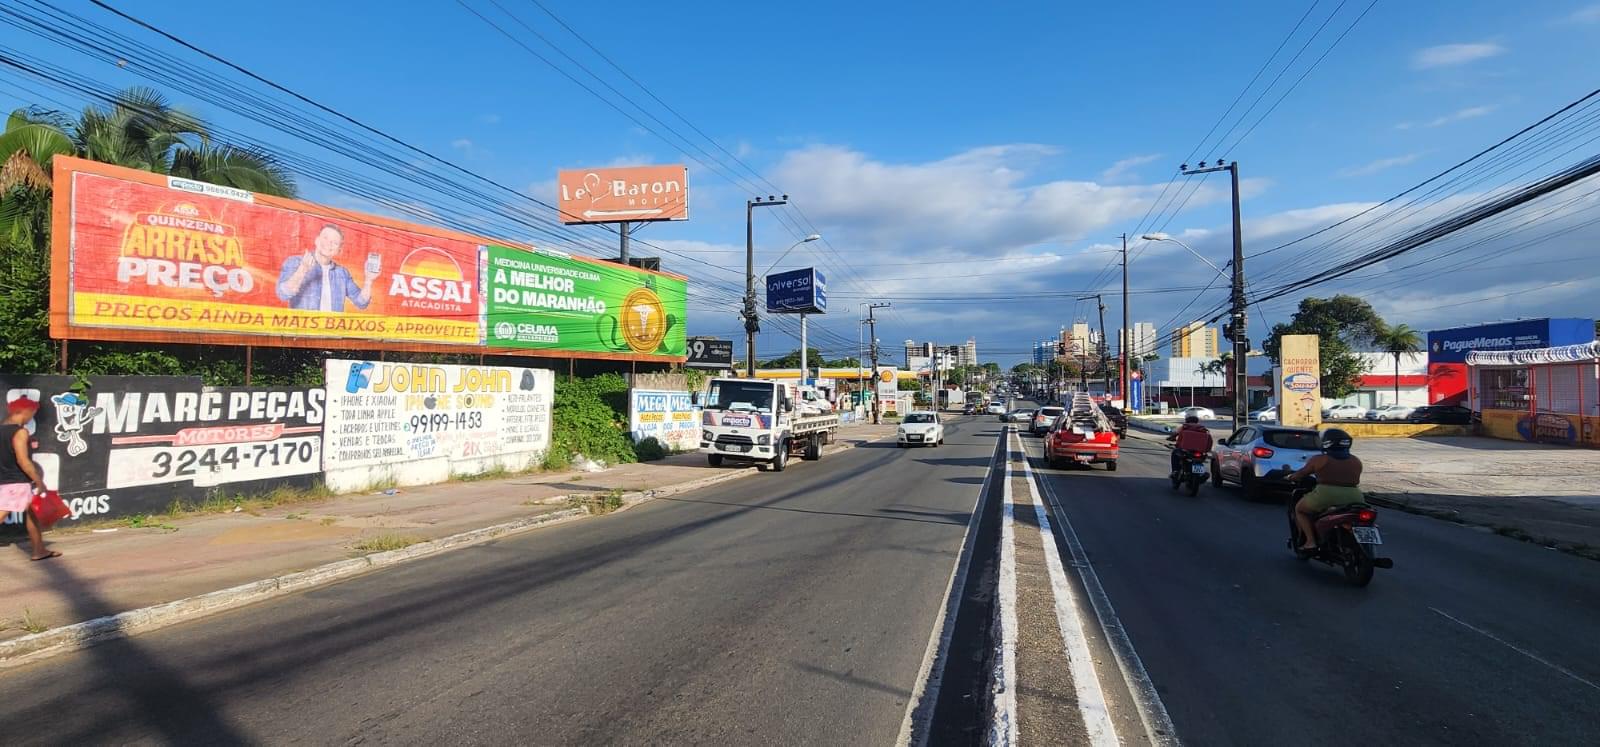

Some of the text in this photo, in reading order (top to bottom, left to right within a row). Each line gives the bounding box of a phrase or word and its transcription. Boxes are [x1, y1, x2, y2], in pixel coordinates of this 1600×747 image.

[613, 180, 680, 197] Baron
[147, 215, 224, 234] QUINZENA
[129, 225, 244, 266] ARRASA
[117, 257, 254, 298] PREÇO
[495, 257, 531, 271] MEDICINA
[531, 263, 579, 278] UNIVERSIDADE
[494, 268, 574, 293] A MELHOR
[401, 299, 462, 312] ATACADISTA
[494, 287, 606, 313] DO MARANHÃO
[94, 301, 192, 322] PREÇOS
[198, 308, 264, 326] AINDA
[271, 314, 319, 329] MAIS
[395, 322, 477, 338] APROVEITE!
[517, 323, 558, 335] CEUMA
[373, 365, 512, 393] JOHN JOHN
[92, 388, 326, 434] MARC PEÇAS
[638, 395, 667, 412] MEGA
[410, 411, 482, 434] 99199-1453
[178, 426, 276, 446] MOTORES
[152, 441, 313, 478] 3244-7170
